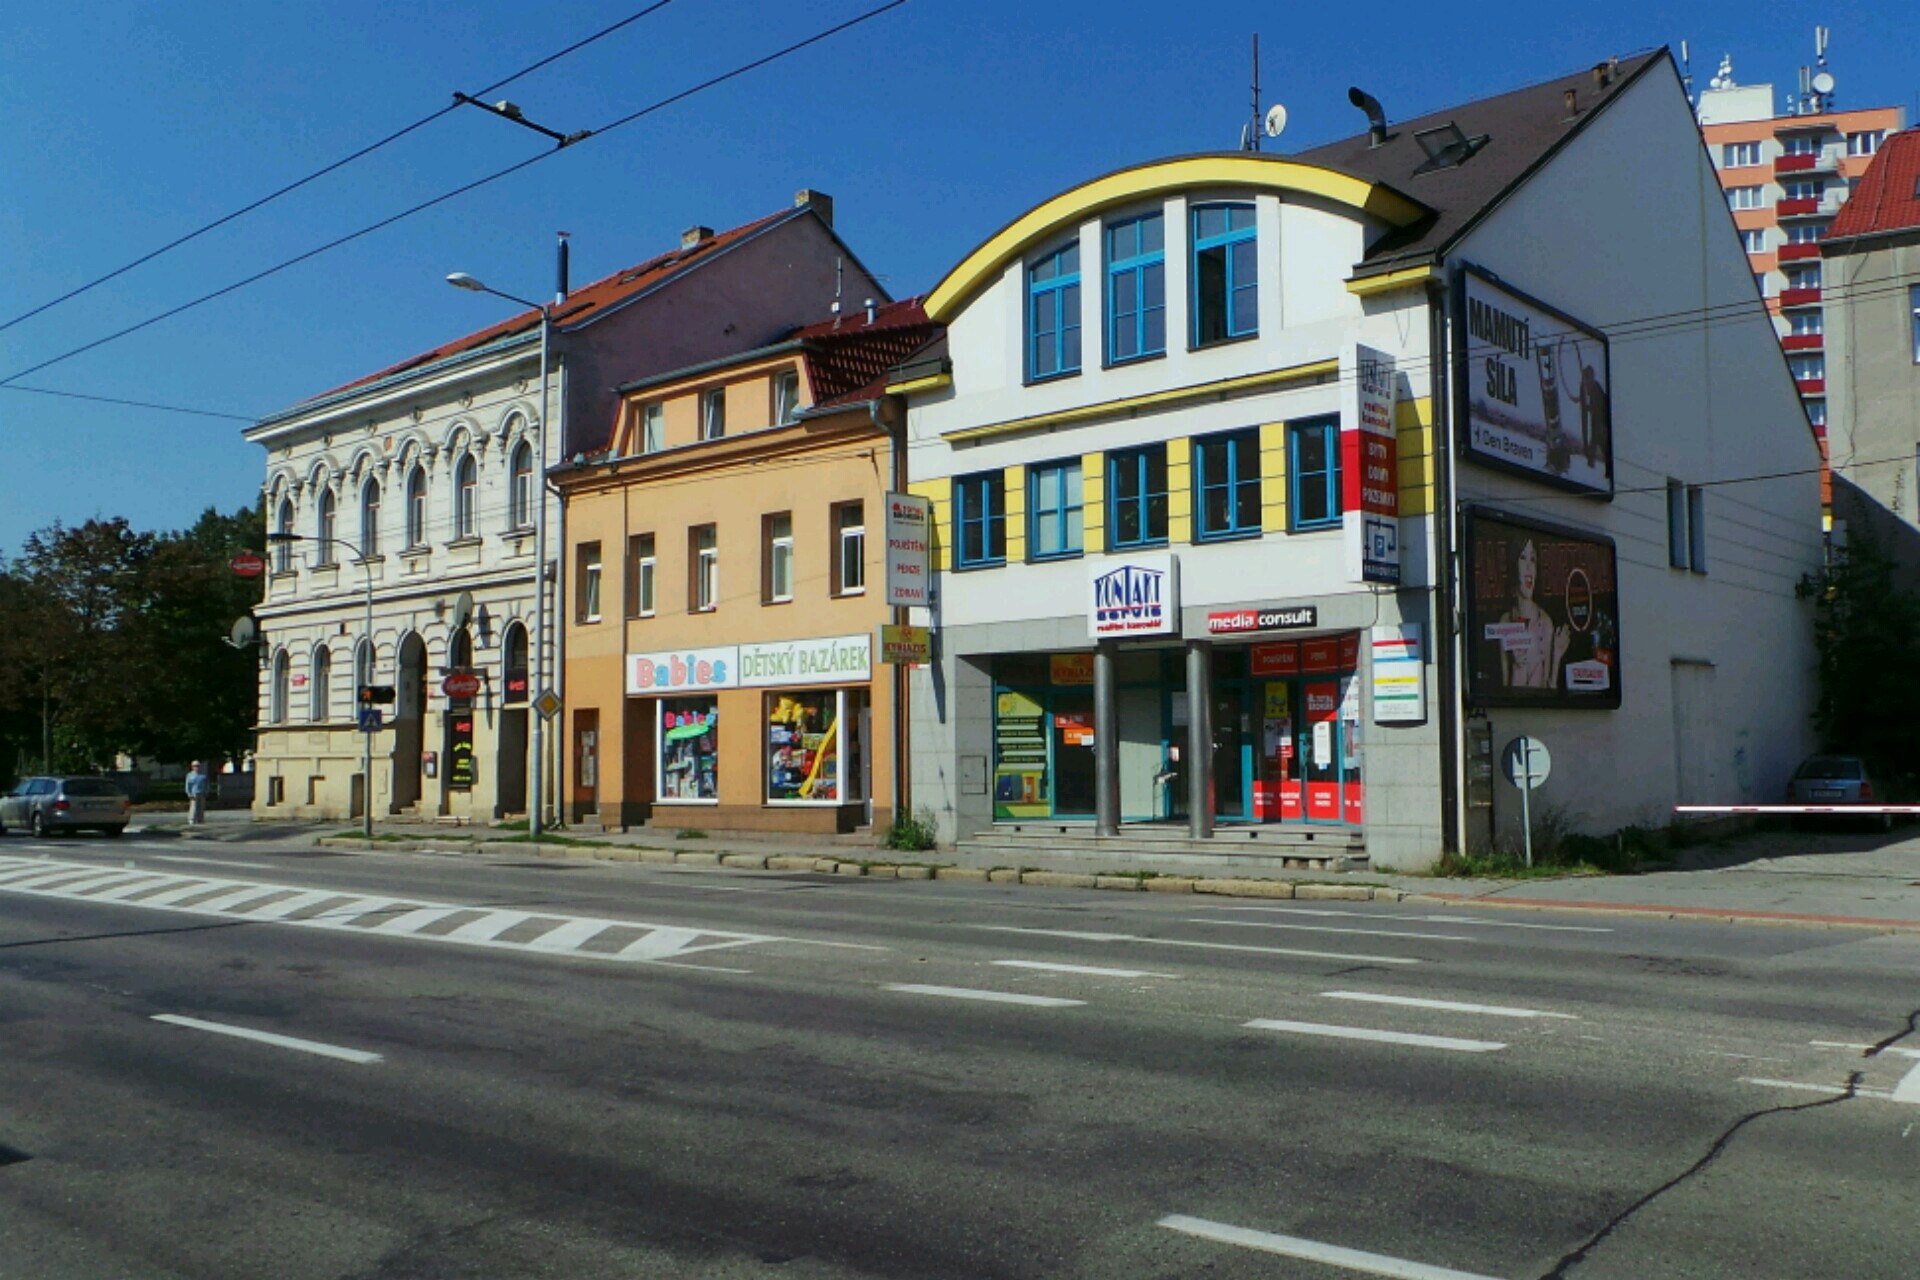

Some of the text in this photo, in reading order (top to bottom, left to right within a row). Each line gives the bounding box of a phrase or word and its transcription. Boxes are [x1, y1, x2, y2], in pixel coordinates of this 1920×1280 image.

[1468, 296, 1529, 361] MAMUTÍ
[1486, 353, 1517, 407] SÍLA
[1094, 565, 1164, 608] KONTAKT
[1209, 609, 1313, 630] media consult
[636, 640, 869, 689] Babies DĚTSKÝ BAZÁREK
